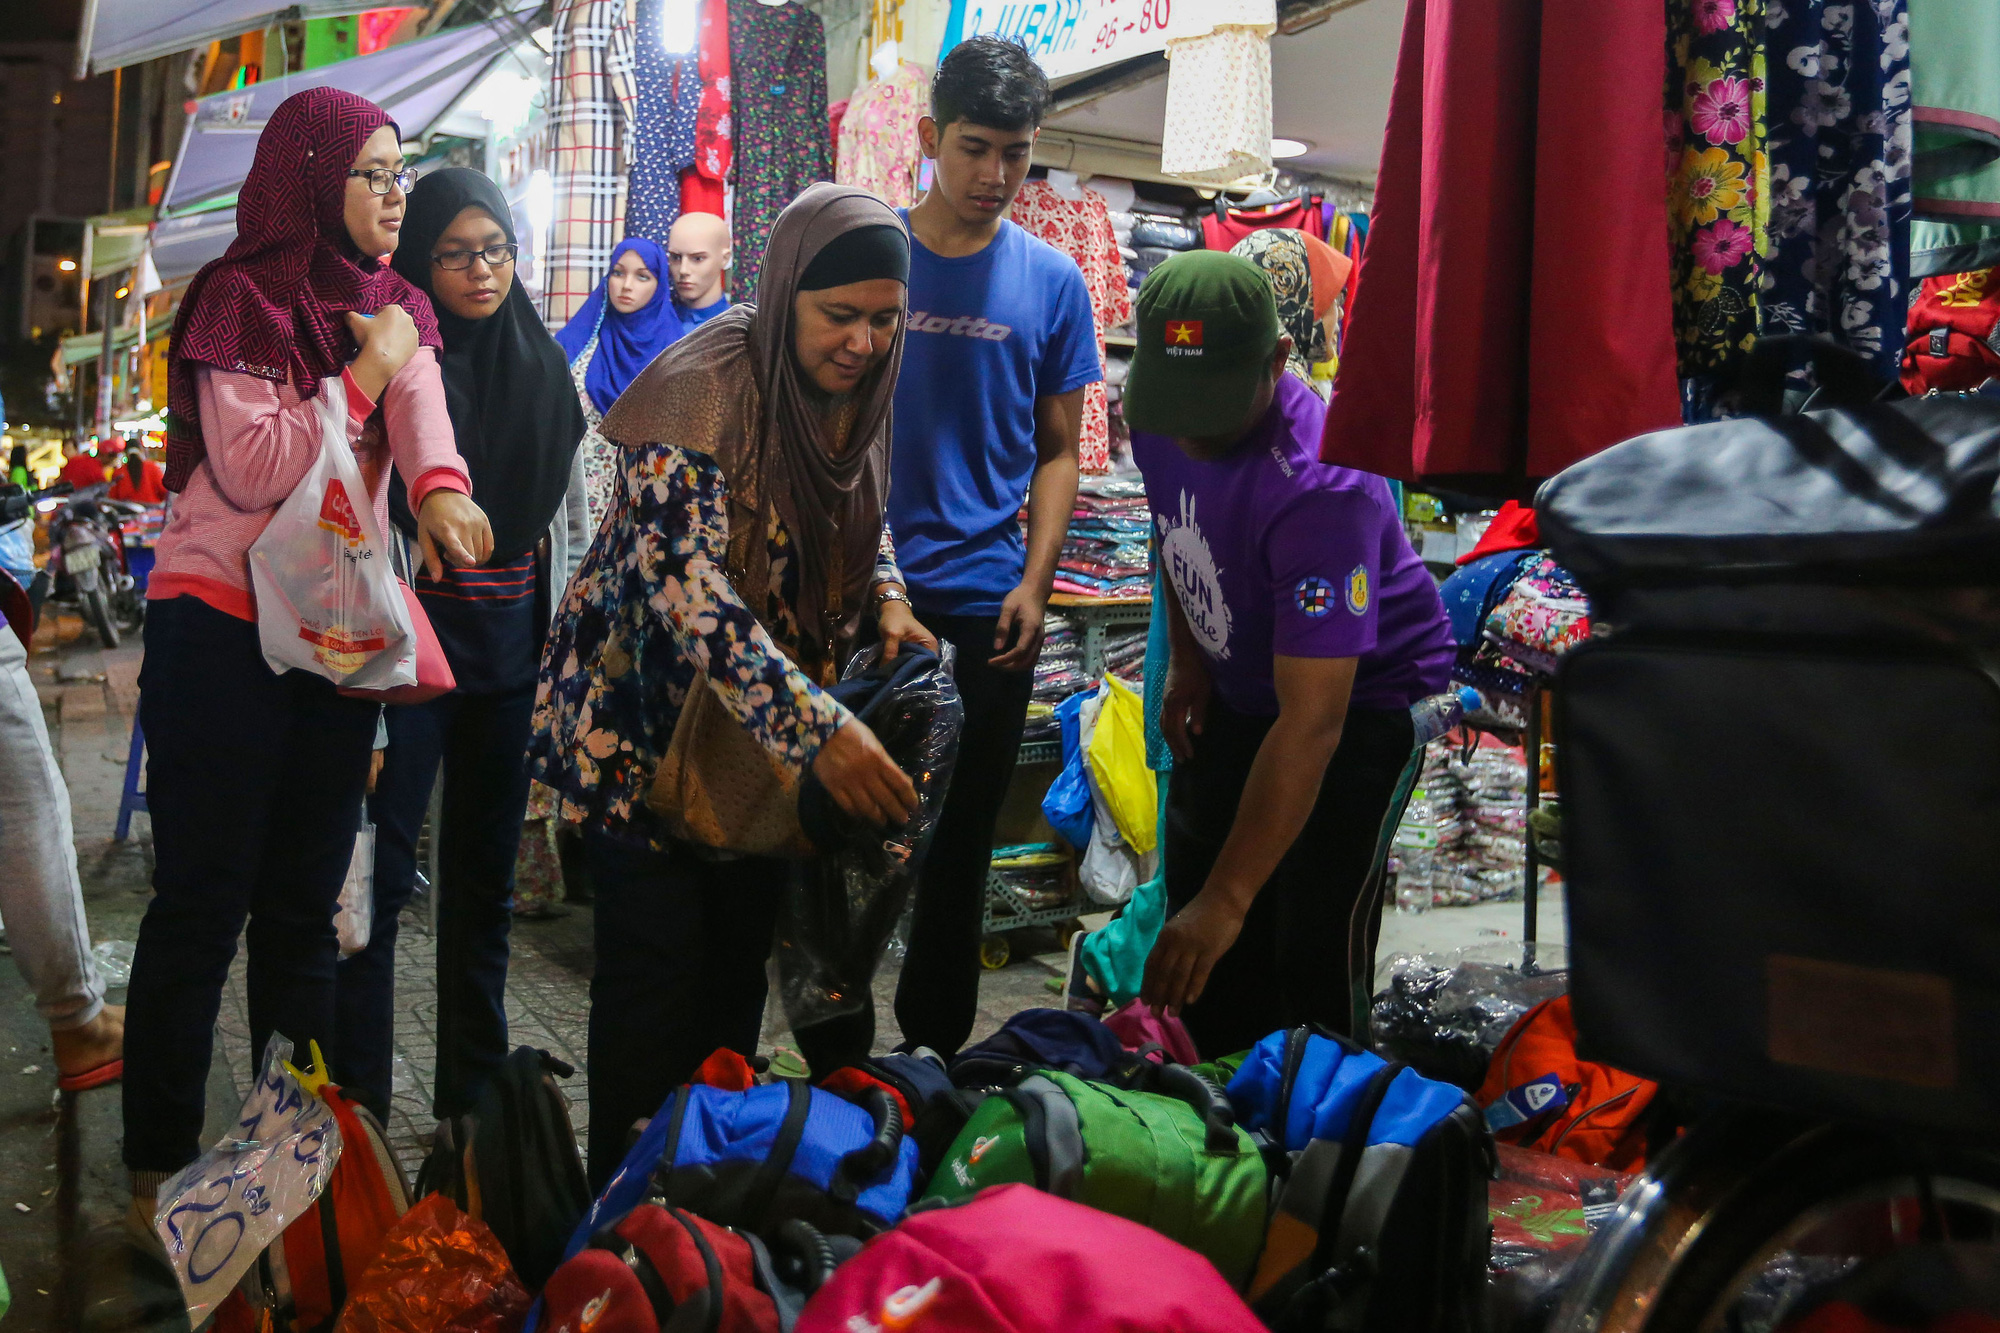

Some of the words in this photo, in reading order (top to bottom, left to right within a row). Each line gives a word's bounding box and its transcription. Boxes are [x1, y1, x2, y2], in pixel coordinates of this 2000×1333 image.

[906, 311, 1012, 342] lotto
[1184, 348, 1203, 356] NAM
[1173, 551, 1213, 614] FUN
[1177, 584, 1219, 642] Ride
